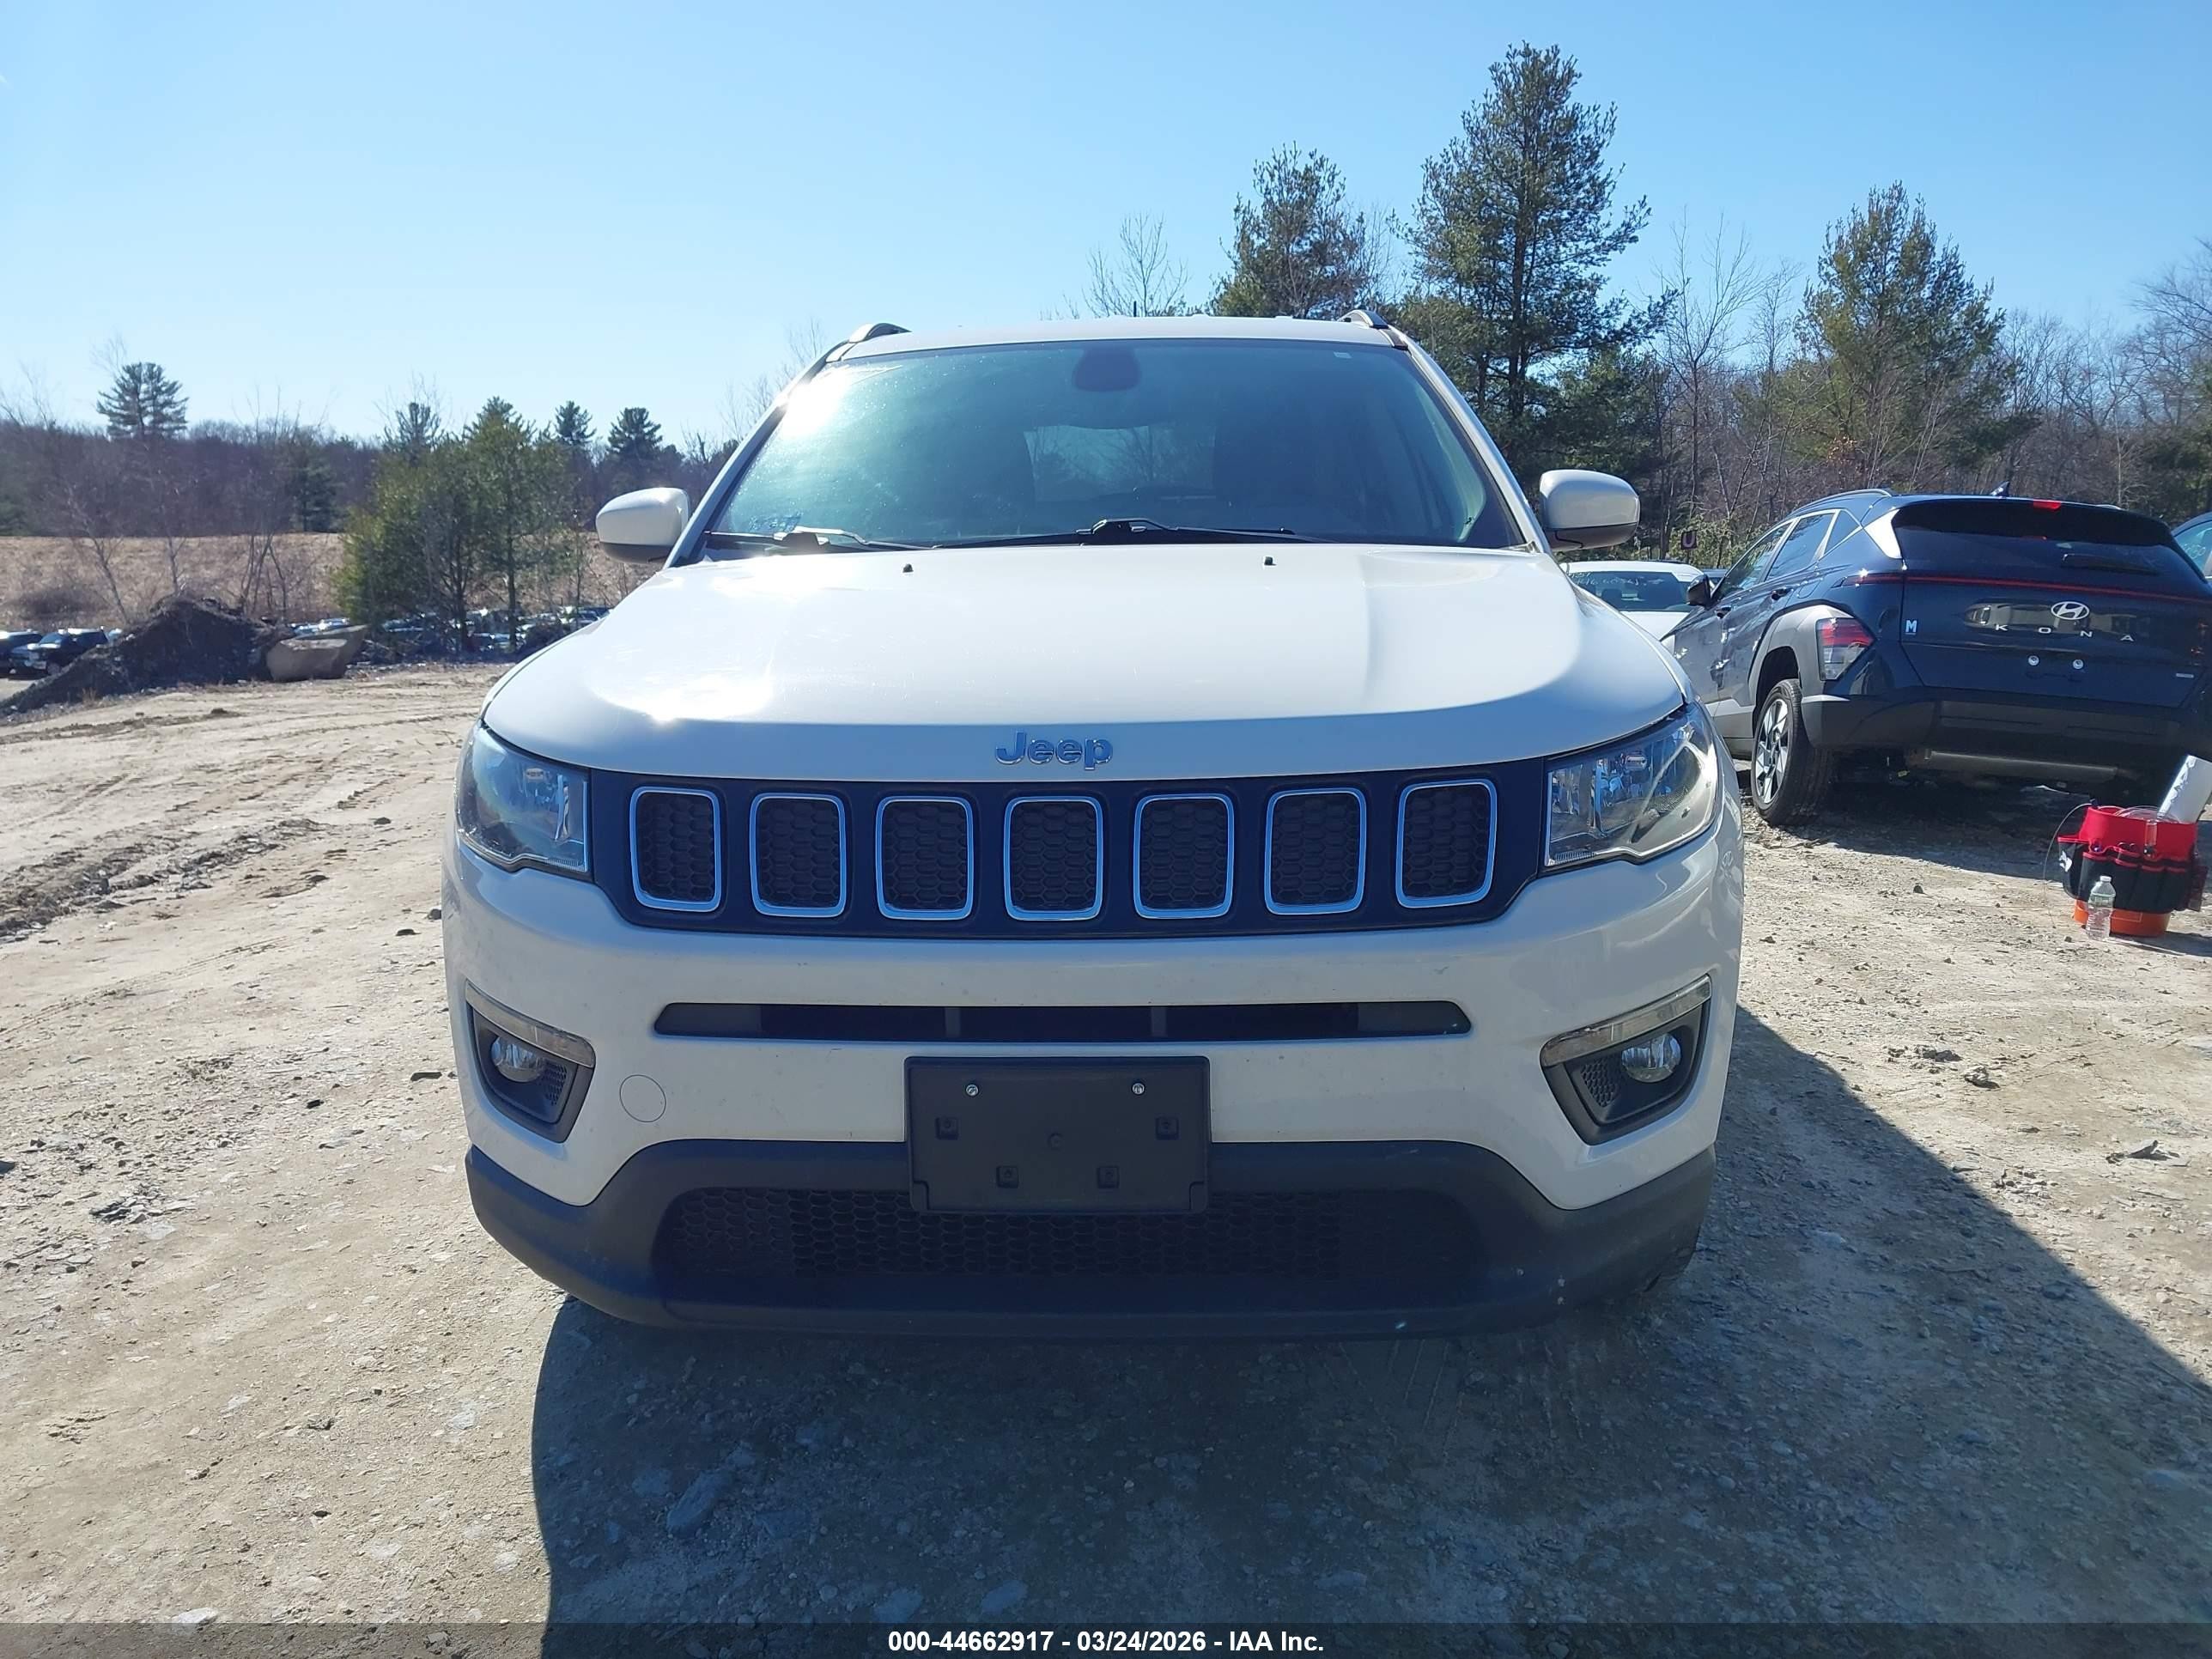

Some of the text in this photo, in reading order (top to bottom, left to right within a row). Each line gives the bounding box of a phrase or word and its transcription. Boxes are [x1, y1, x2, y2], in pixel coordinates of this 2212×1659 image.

[1683, 531, 1696, 548] U
[1995, 624, 2134, 642] KONA
[995, 731, 1114, 770] Jeep
